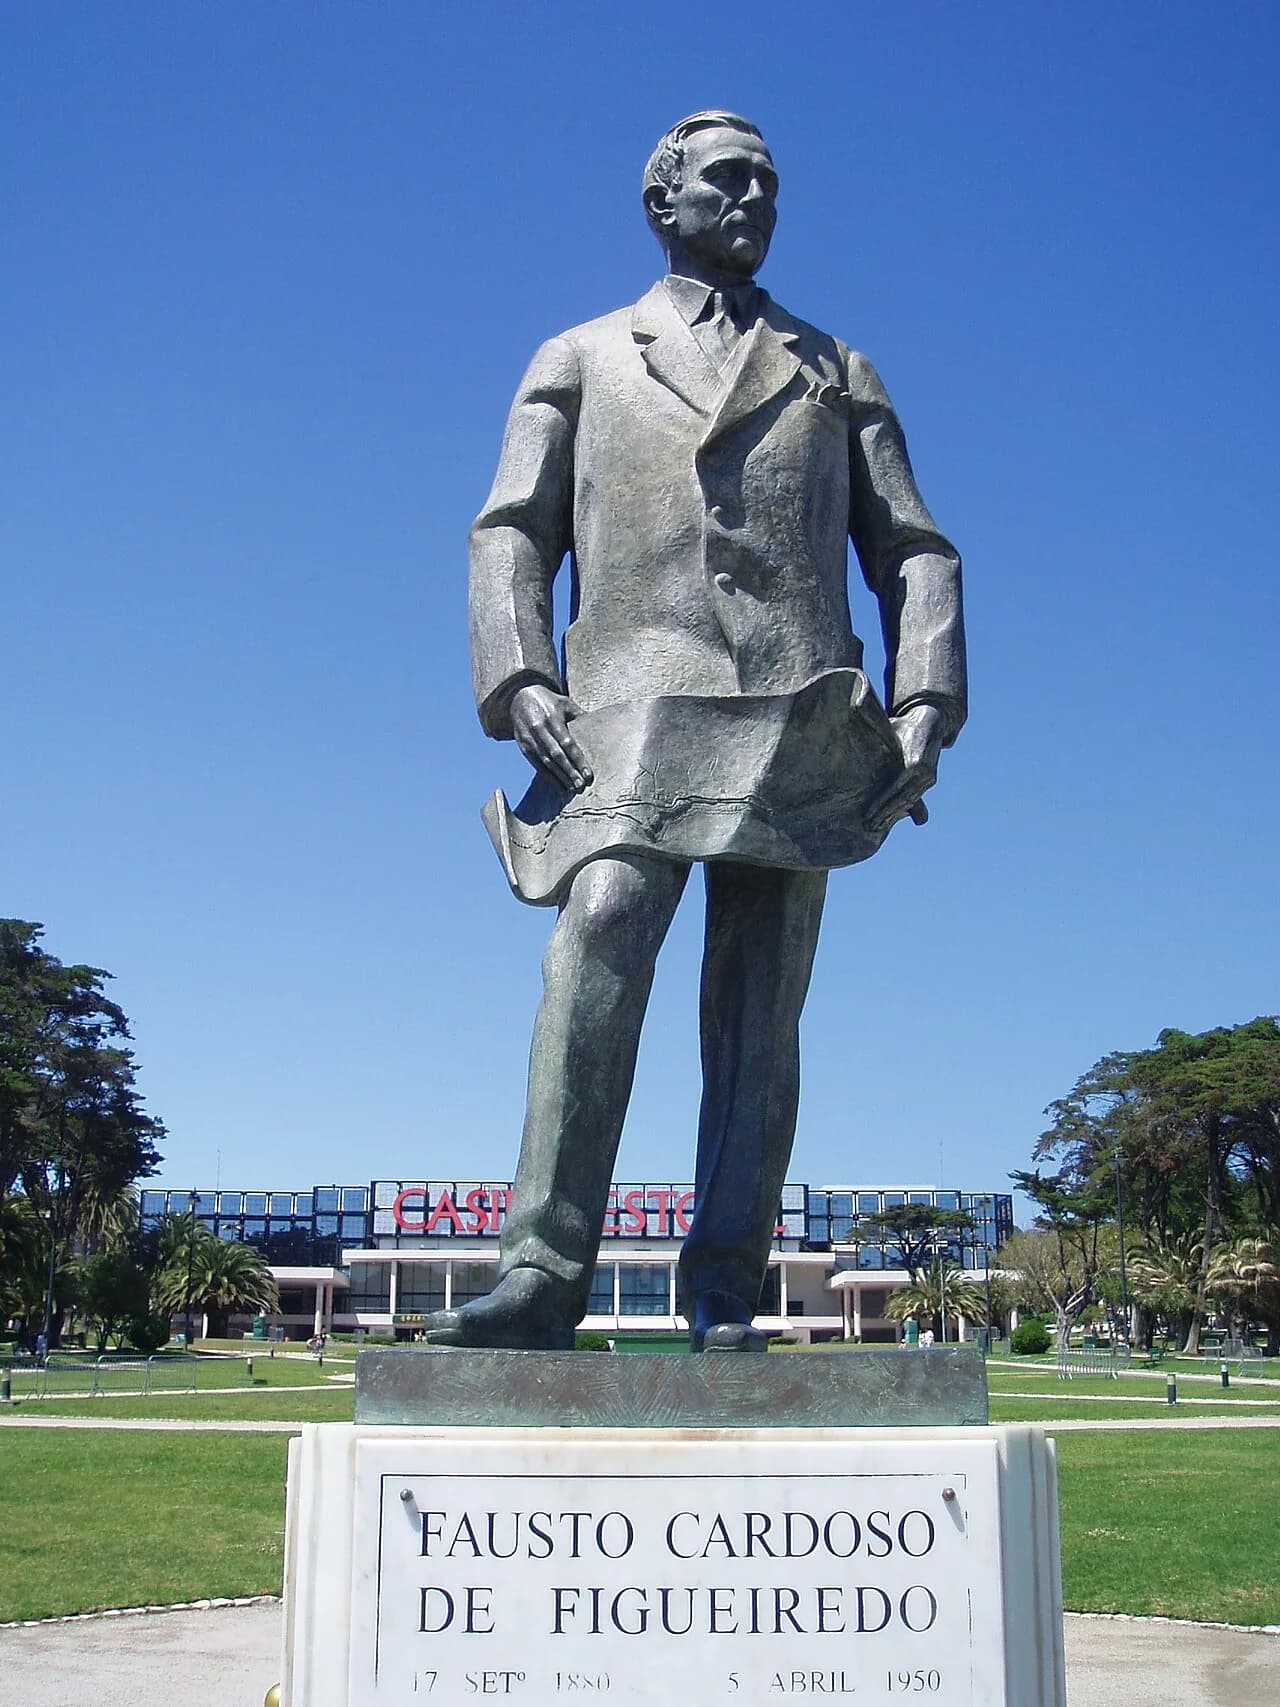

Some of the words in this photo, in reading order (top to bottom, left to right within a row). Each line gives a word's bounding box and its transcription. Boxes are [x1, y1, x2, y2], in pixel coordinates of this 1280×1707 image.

[417, 1511, 634, 1559] FAUSTO
[666, 1510, 935, 1559] CARDOSO
[417, 1587, 496, 1634] DE
[550, 1586, 937, 1635] FIGUEIREDO
[413, 1671, 439, 1693] 17
[727, 1672, 740, 1693] 5
[769, 1671, 856, 1693] ABRIL
[887, 1669, 942, 1692] 1950
